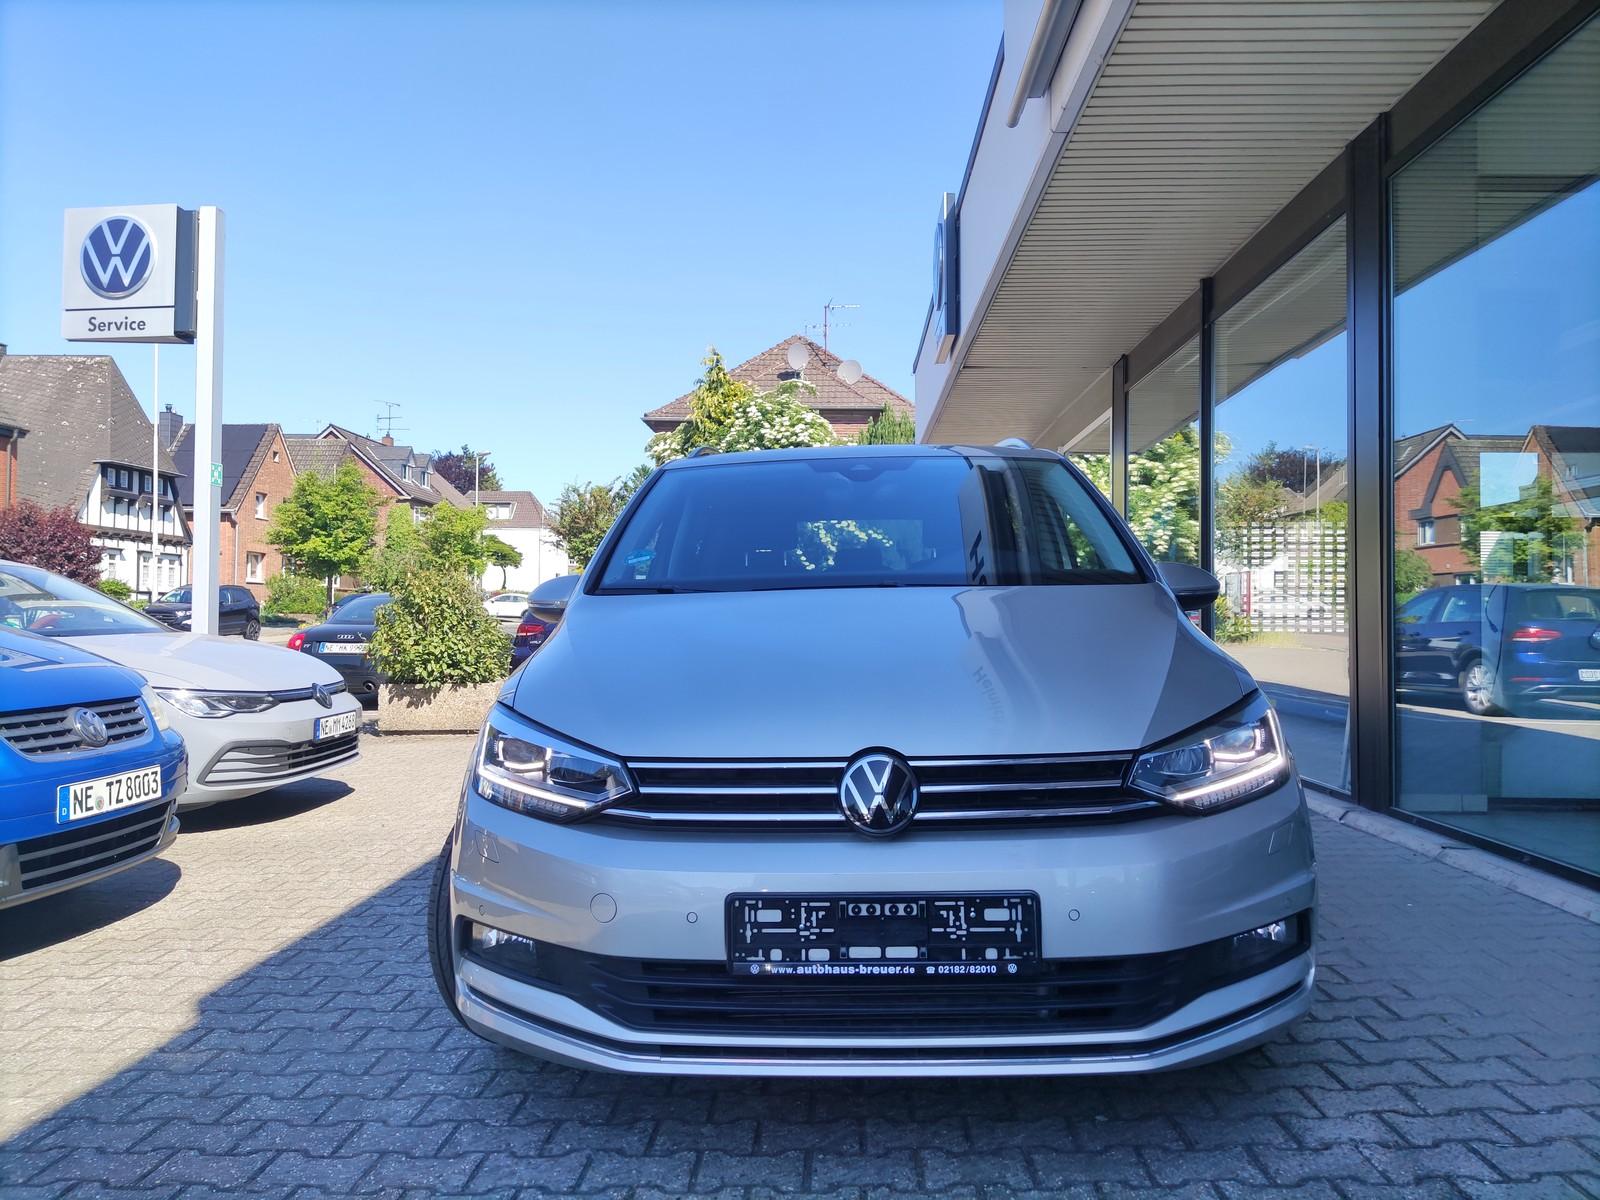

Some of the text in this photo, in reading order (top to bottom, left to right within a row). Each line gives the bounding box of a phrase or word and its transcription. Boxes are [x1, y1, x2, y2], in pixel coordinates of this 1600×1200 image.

[83, 218, 152, 294] VW
[87, 315, 147, 333] Service
[73, 785, 94, 816] NE
[843, 755, 914, 830] VW
[771, 964, 915, 974] www.autohaus-breuer.de
[938, 964, 997, 974] 02182/82010
